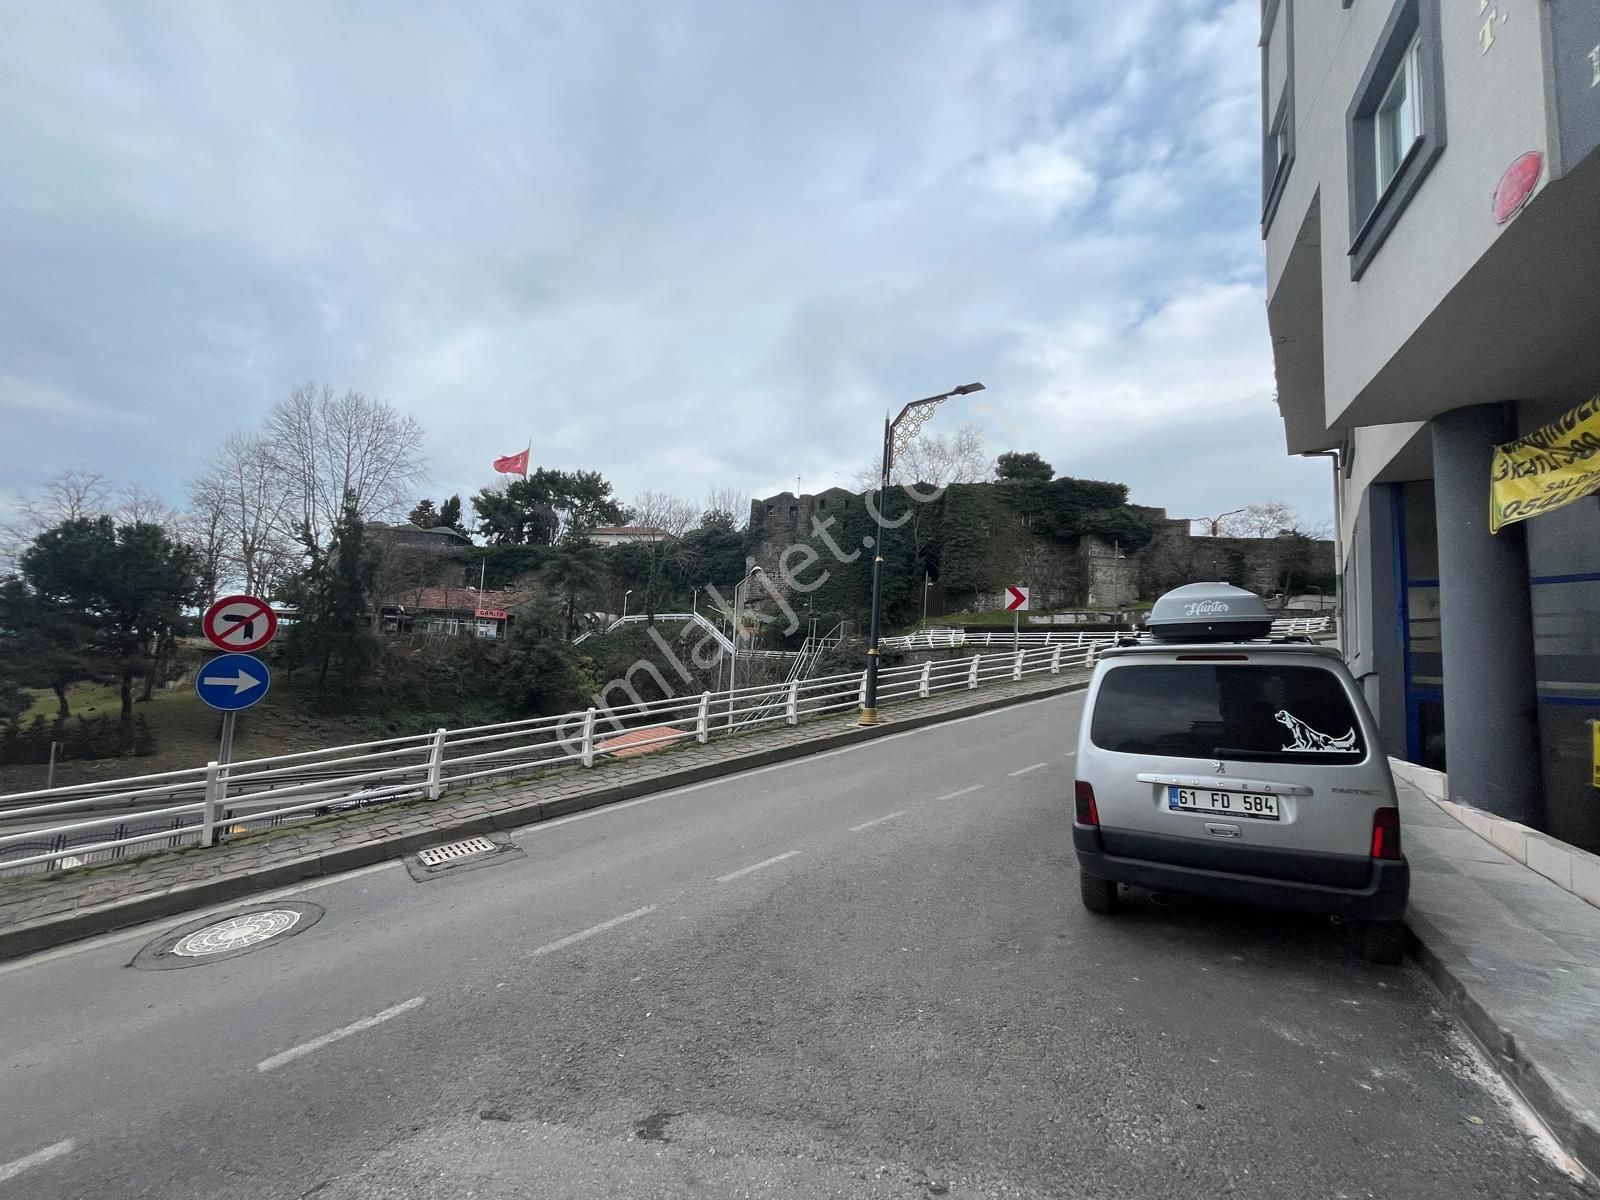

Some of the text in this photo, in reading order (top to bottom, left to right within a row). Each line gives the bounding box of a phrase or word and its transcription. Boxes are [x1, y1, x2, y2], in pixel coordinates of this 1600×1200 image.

[1184, 599, 1231, 617] Hunter
[1179, 790, 1196, 806] 61
[1211, 792, 1230, 809] FD
[1243, 795, 1274, 813] 584
